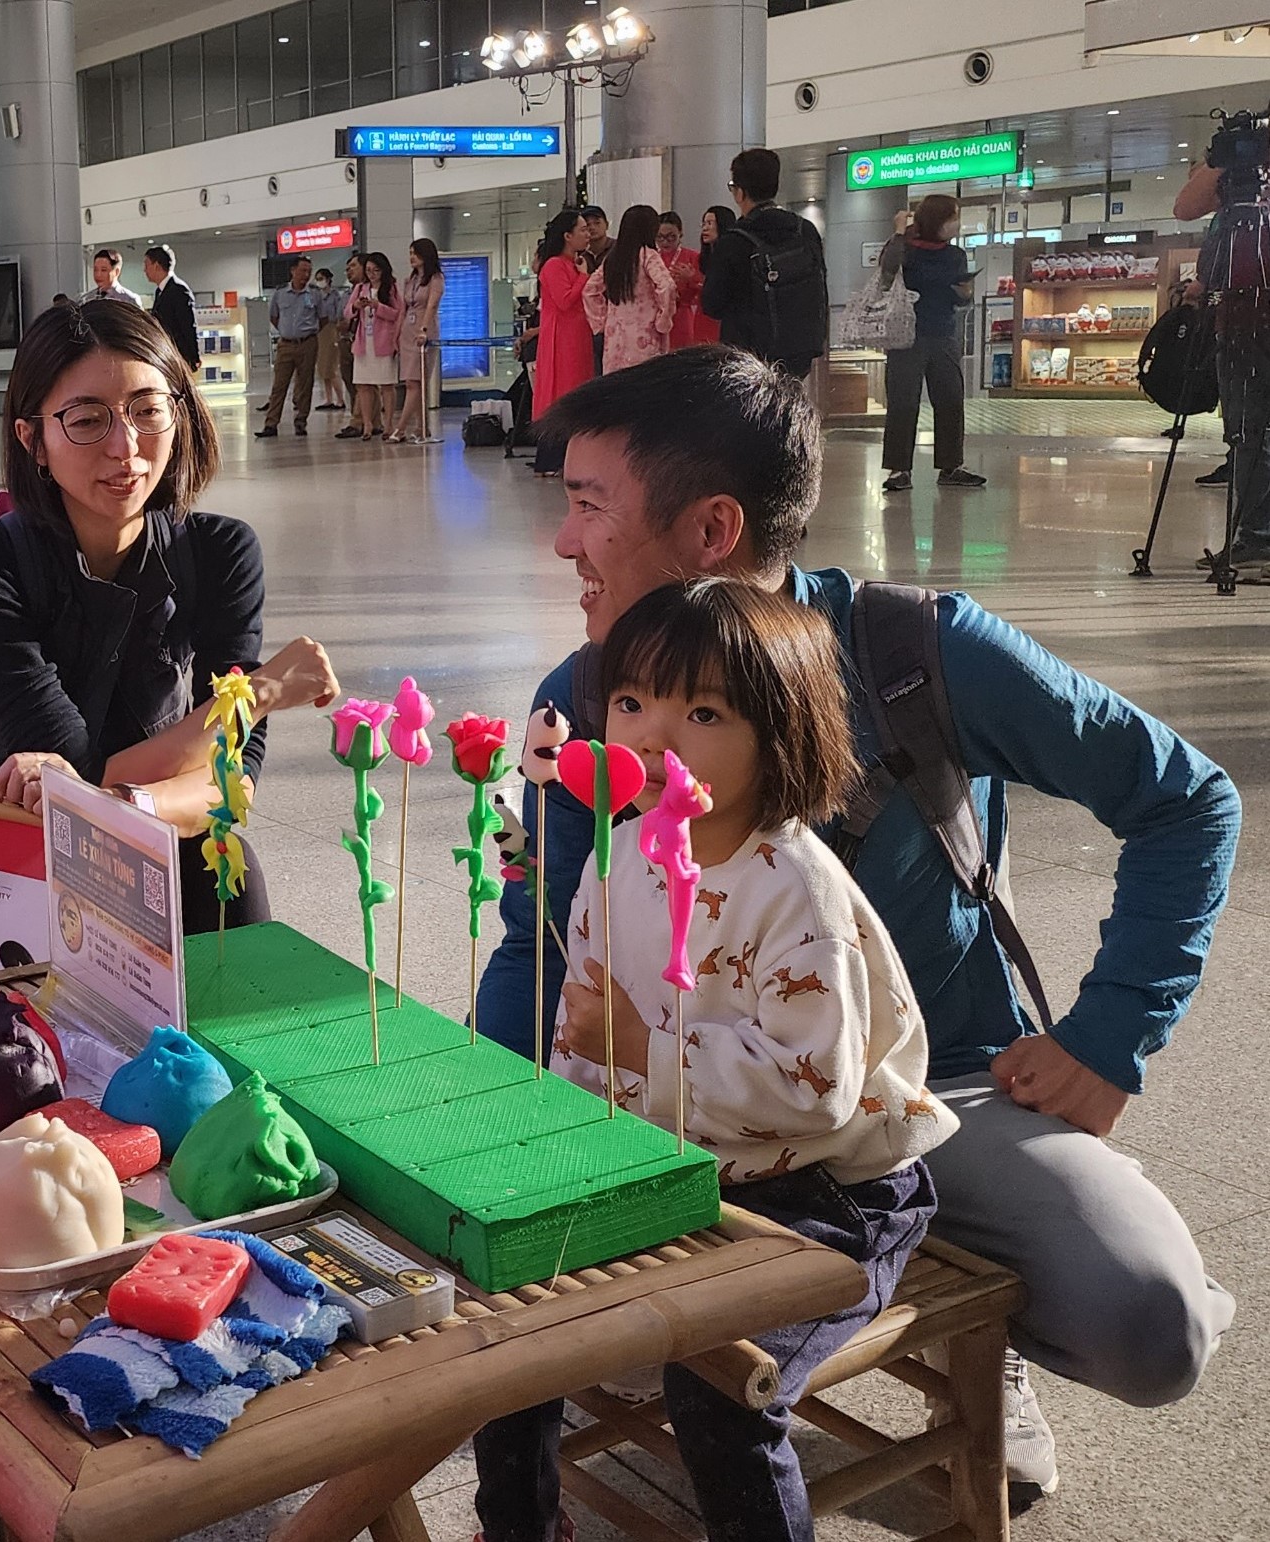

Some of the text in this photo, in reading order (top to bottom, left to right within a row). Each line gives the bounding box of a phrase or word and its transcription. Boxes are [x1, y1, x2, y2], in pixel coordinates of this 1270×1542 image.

[880, 140, 1011, 167] KHÔNG KHAI BÁO HẢI QUAN
[880, 162, 960, 180] Nothing to declare
[885, 677, 925, 704] patagonia
